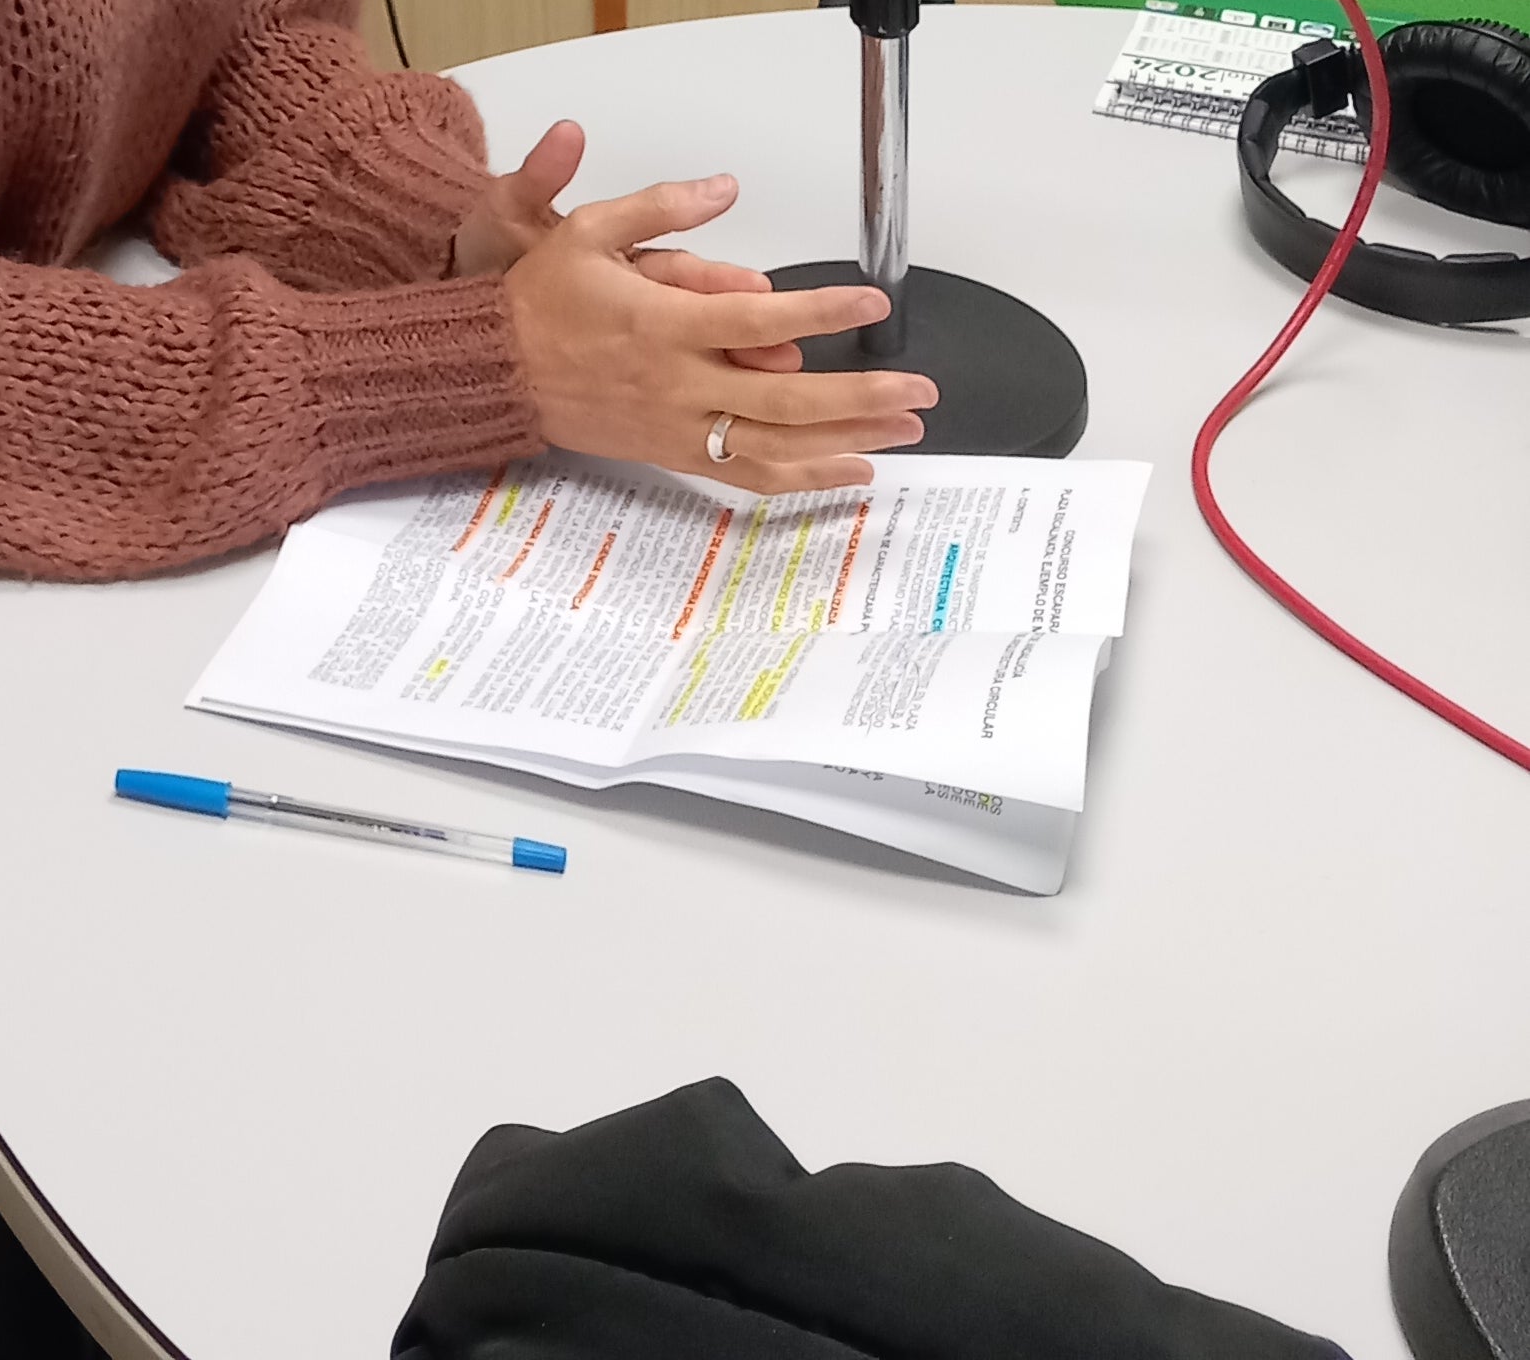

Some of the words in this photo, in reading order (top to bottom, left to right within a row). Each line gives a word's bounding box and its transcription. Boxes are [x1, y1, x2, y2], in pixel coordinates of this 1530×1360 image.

[1131, 58, 1218, 83] 2024
[1057, 488, 1073, 511] PLAZA
[935, 543, 961, 612] ARQUITECTURA
[1056, 530, 1076, 580] CONCURSO
[825, 550, 858, 626] RENATURALIZADA
[1035, 561, 1053, 607] EJEMPLO
[1032, 609, 1045, 623] DE
[981, 686, 1002, 739] CIRCULAR
